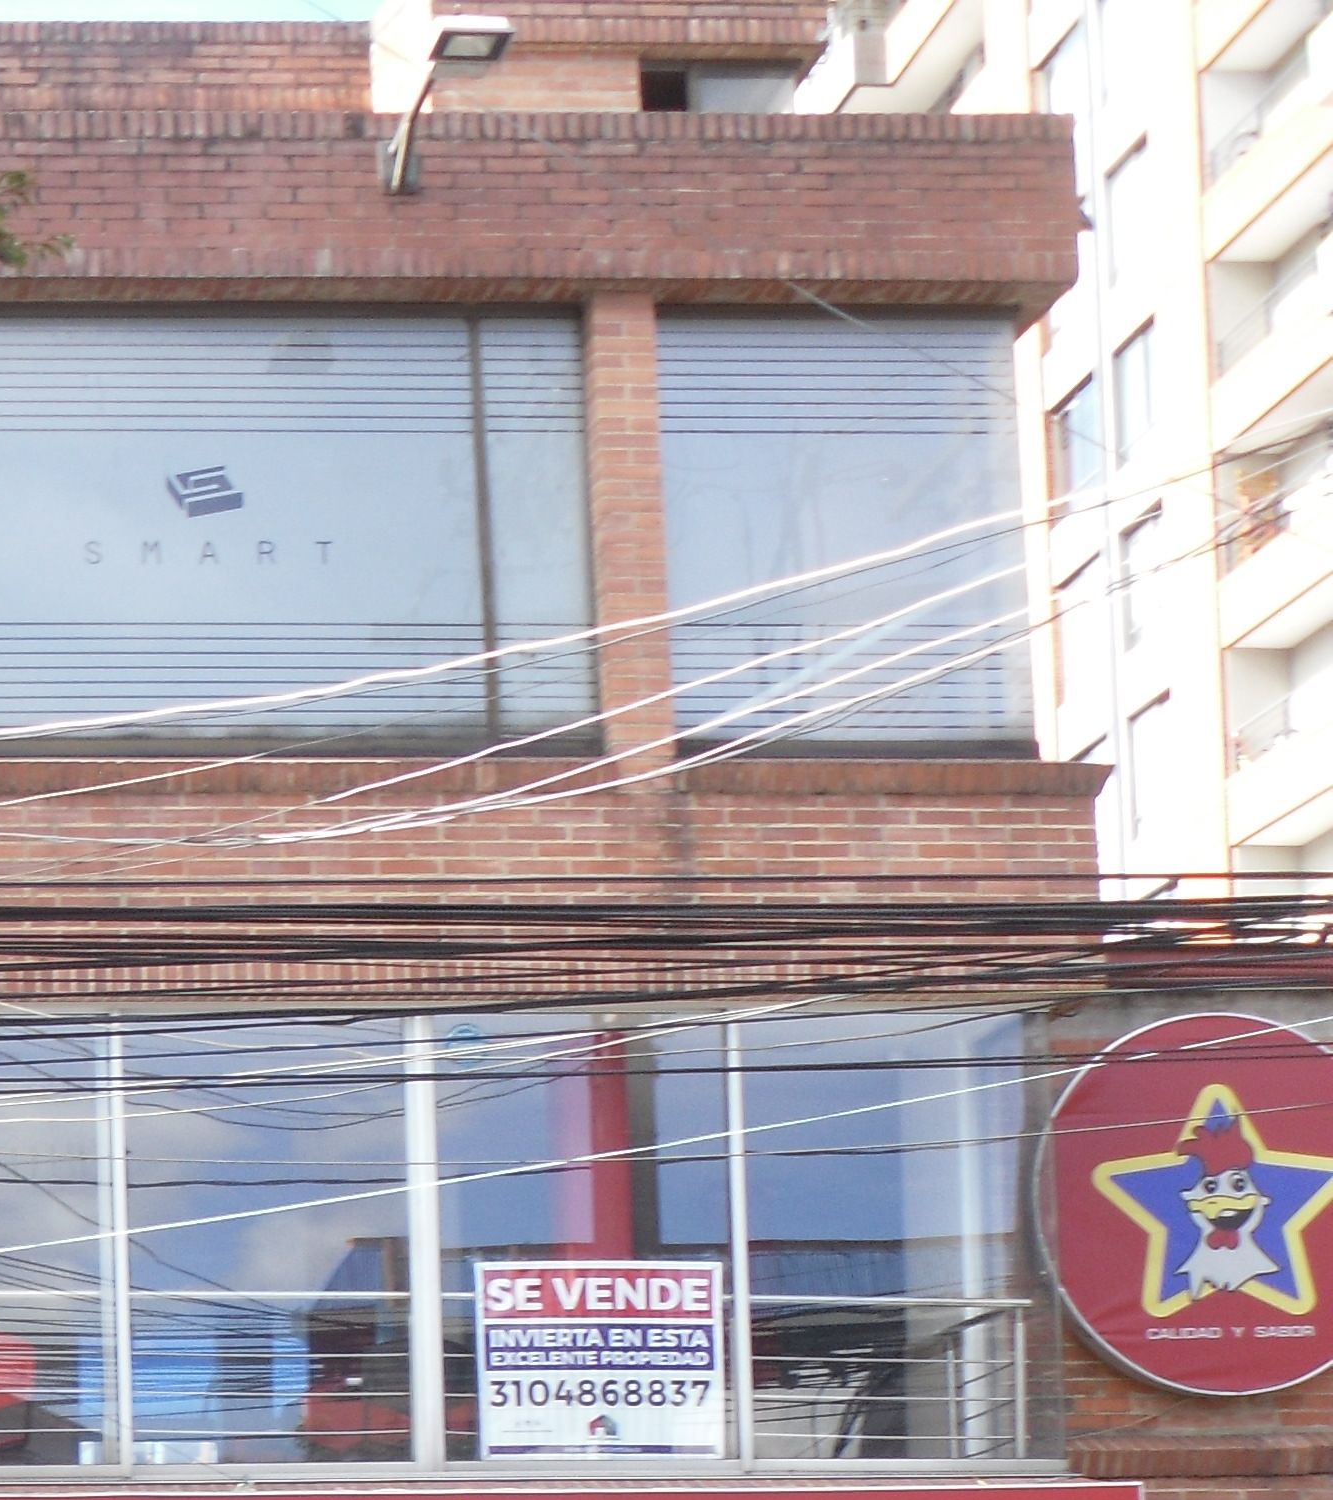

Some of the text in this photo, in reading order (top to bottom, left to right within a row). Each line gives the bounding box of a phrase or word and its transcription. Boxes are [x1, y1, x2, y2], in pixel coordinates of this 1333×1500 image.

[84, 540, 333, 565] SMART
[486, 1277, 711, 1312] SE VENDE
[489, 1328, 710, 1348] INVIERTA EN ESTA
[1146, 1325, 1316, 1340] CALIDAD Y SABOR
[490, 1351, 711, 1366] EXCELENTE PROPIEDAD
[489, 1380, 711, 1407] 3104868837
